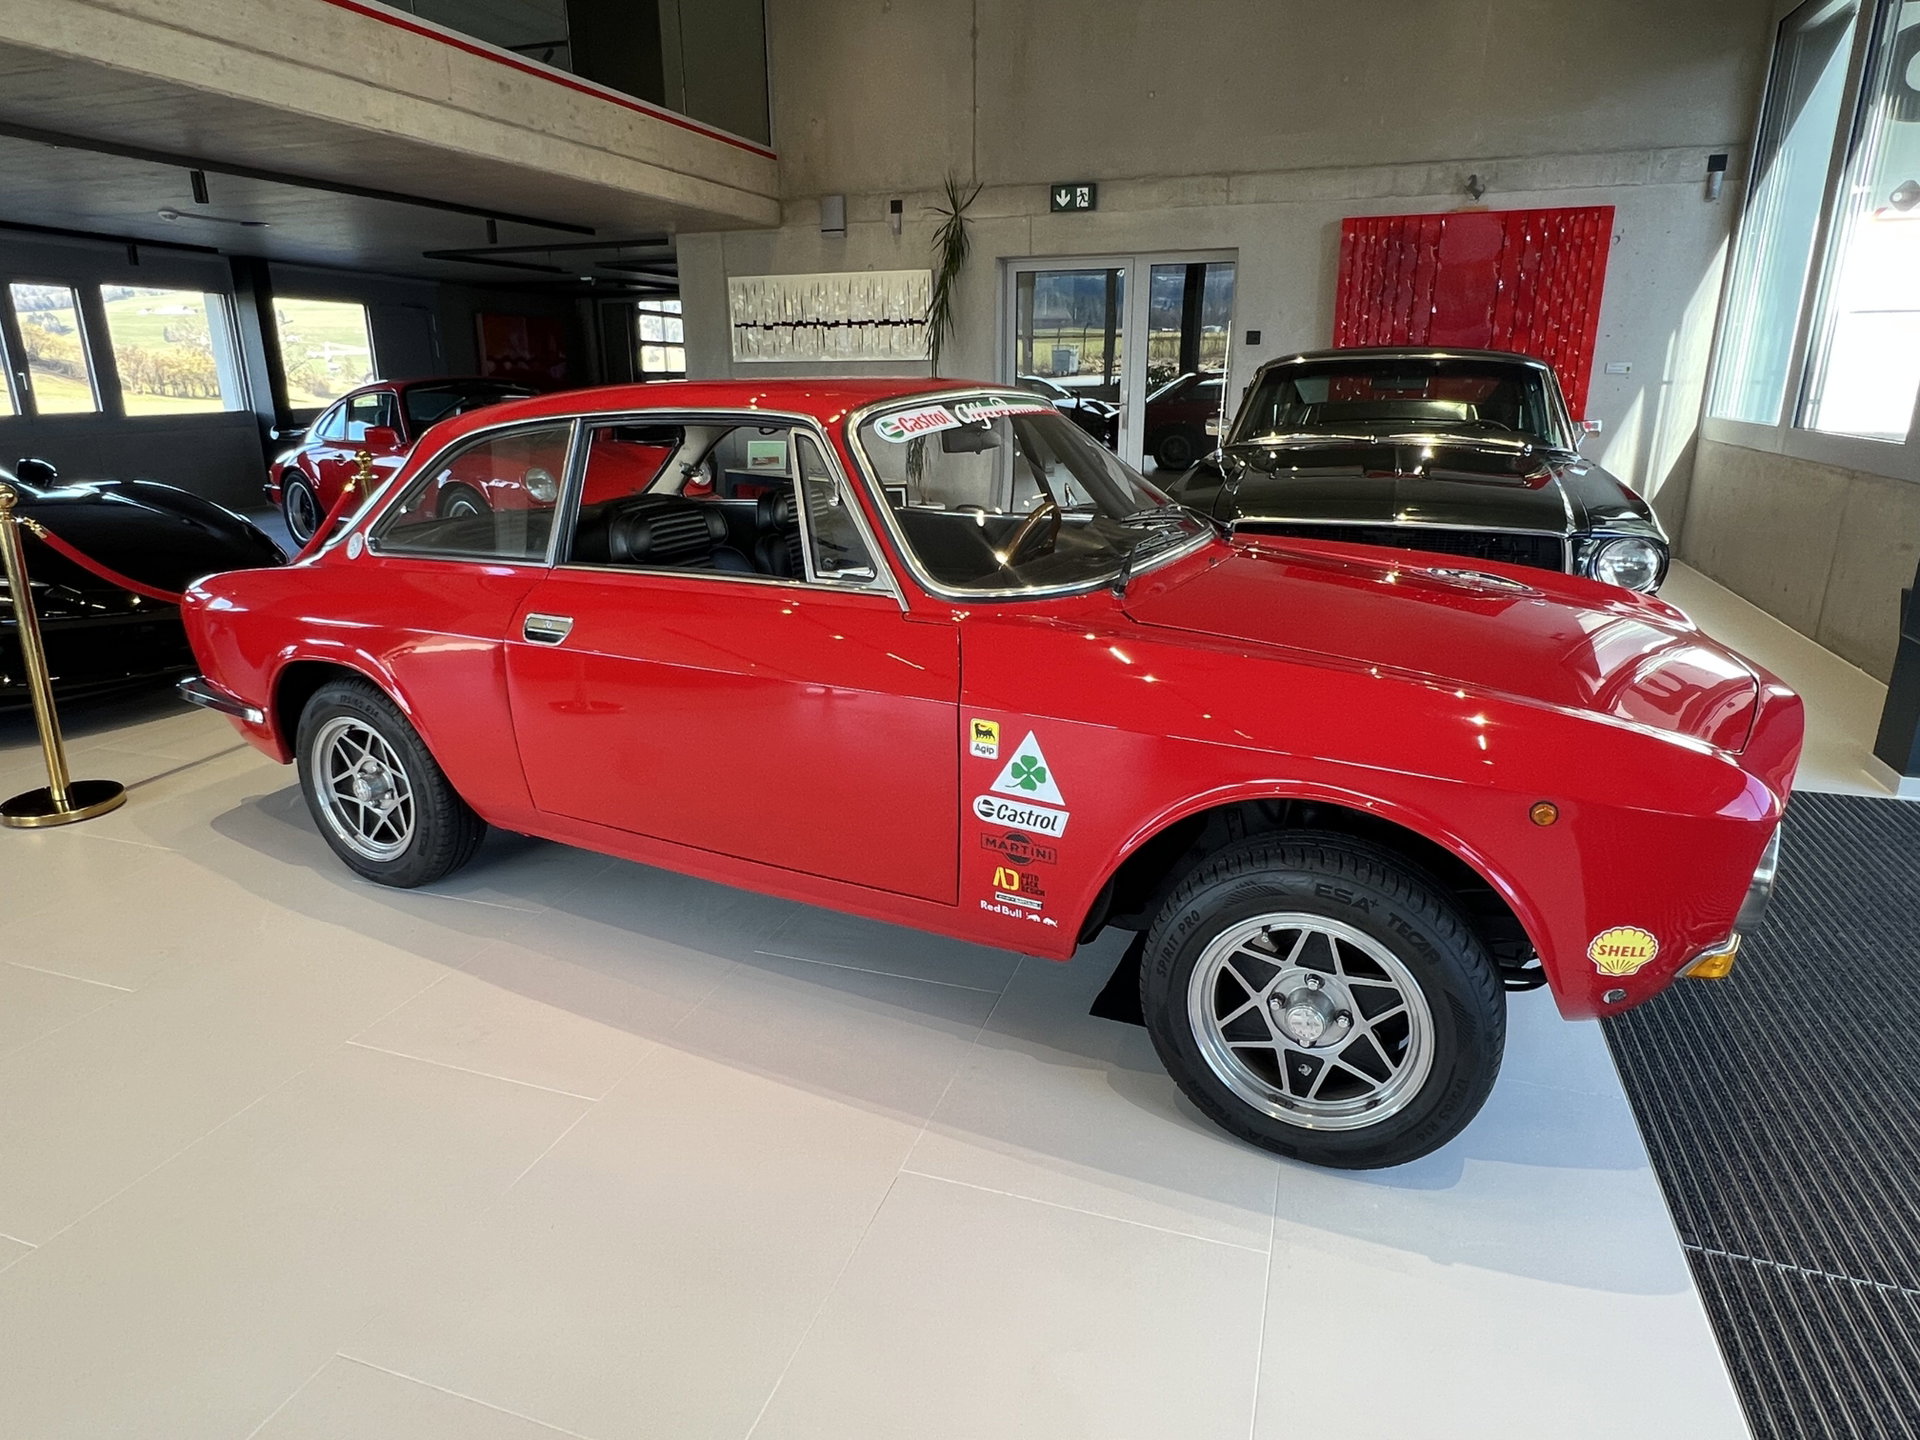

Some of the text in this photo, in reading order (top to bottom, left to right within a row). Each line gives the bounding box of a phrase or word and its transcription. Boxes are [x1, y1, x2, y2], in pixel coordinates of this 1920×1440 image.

[900, 410, 952, 433] Castrol
[974, 743, 995, 755] Agip
[996, 803, 1058, 831] Castrol
[984, 837, 1052, 860] MARTINI
[980, 900, 1001, 913] Red
[1002, 905, 1023, 919] Bull
[1156, 910, 1200, 978] SPIRIT PRO
[1386, 911, 1442, 966] TECAR
[1598, 944, 1647, 958] SHELL
